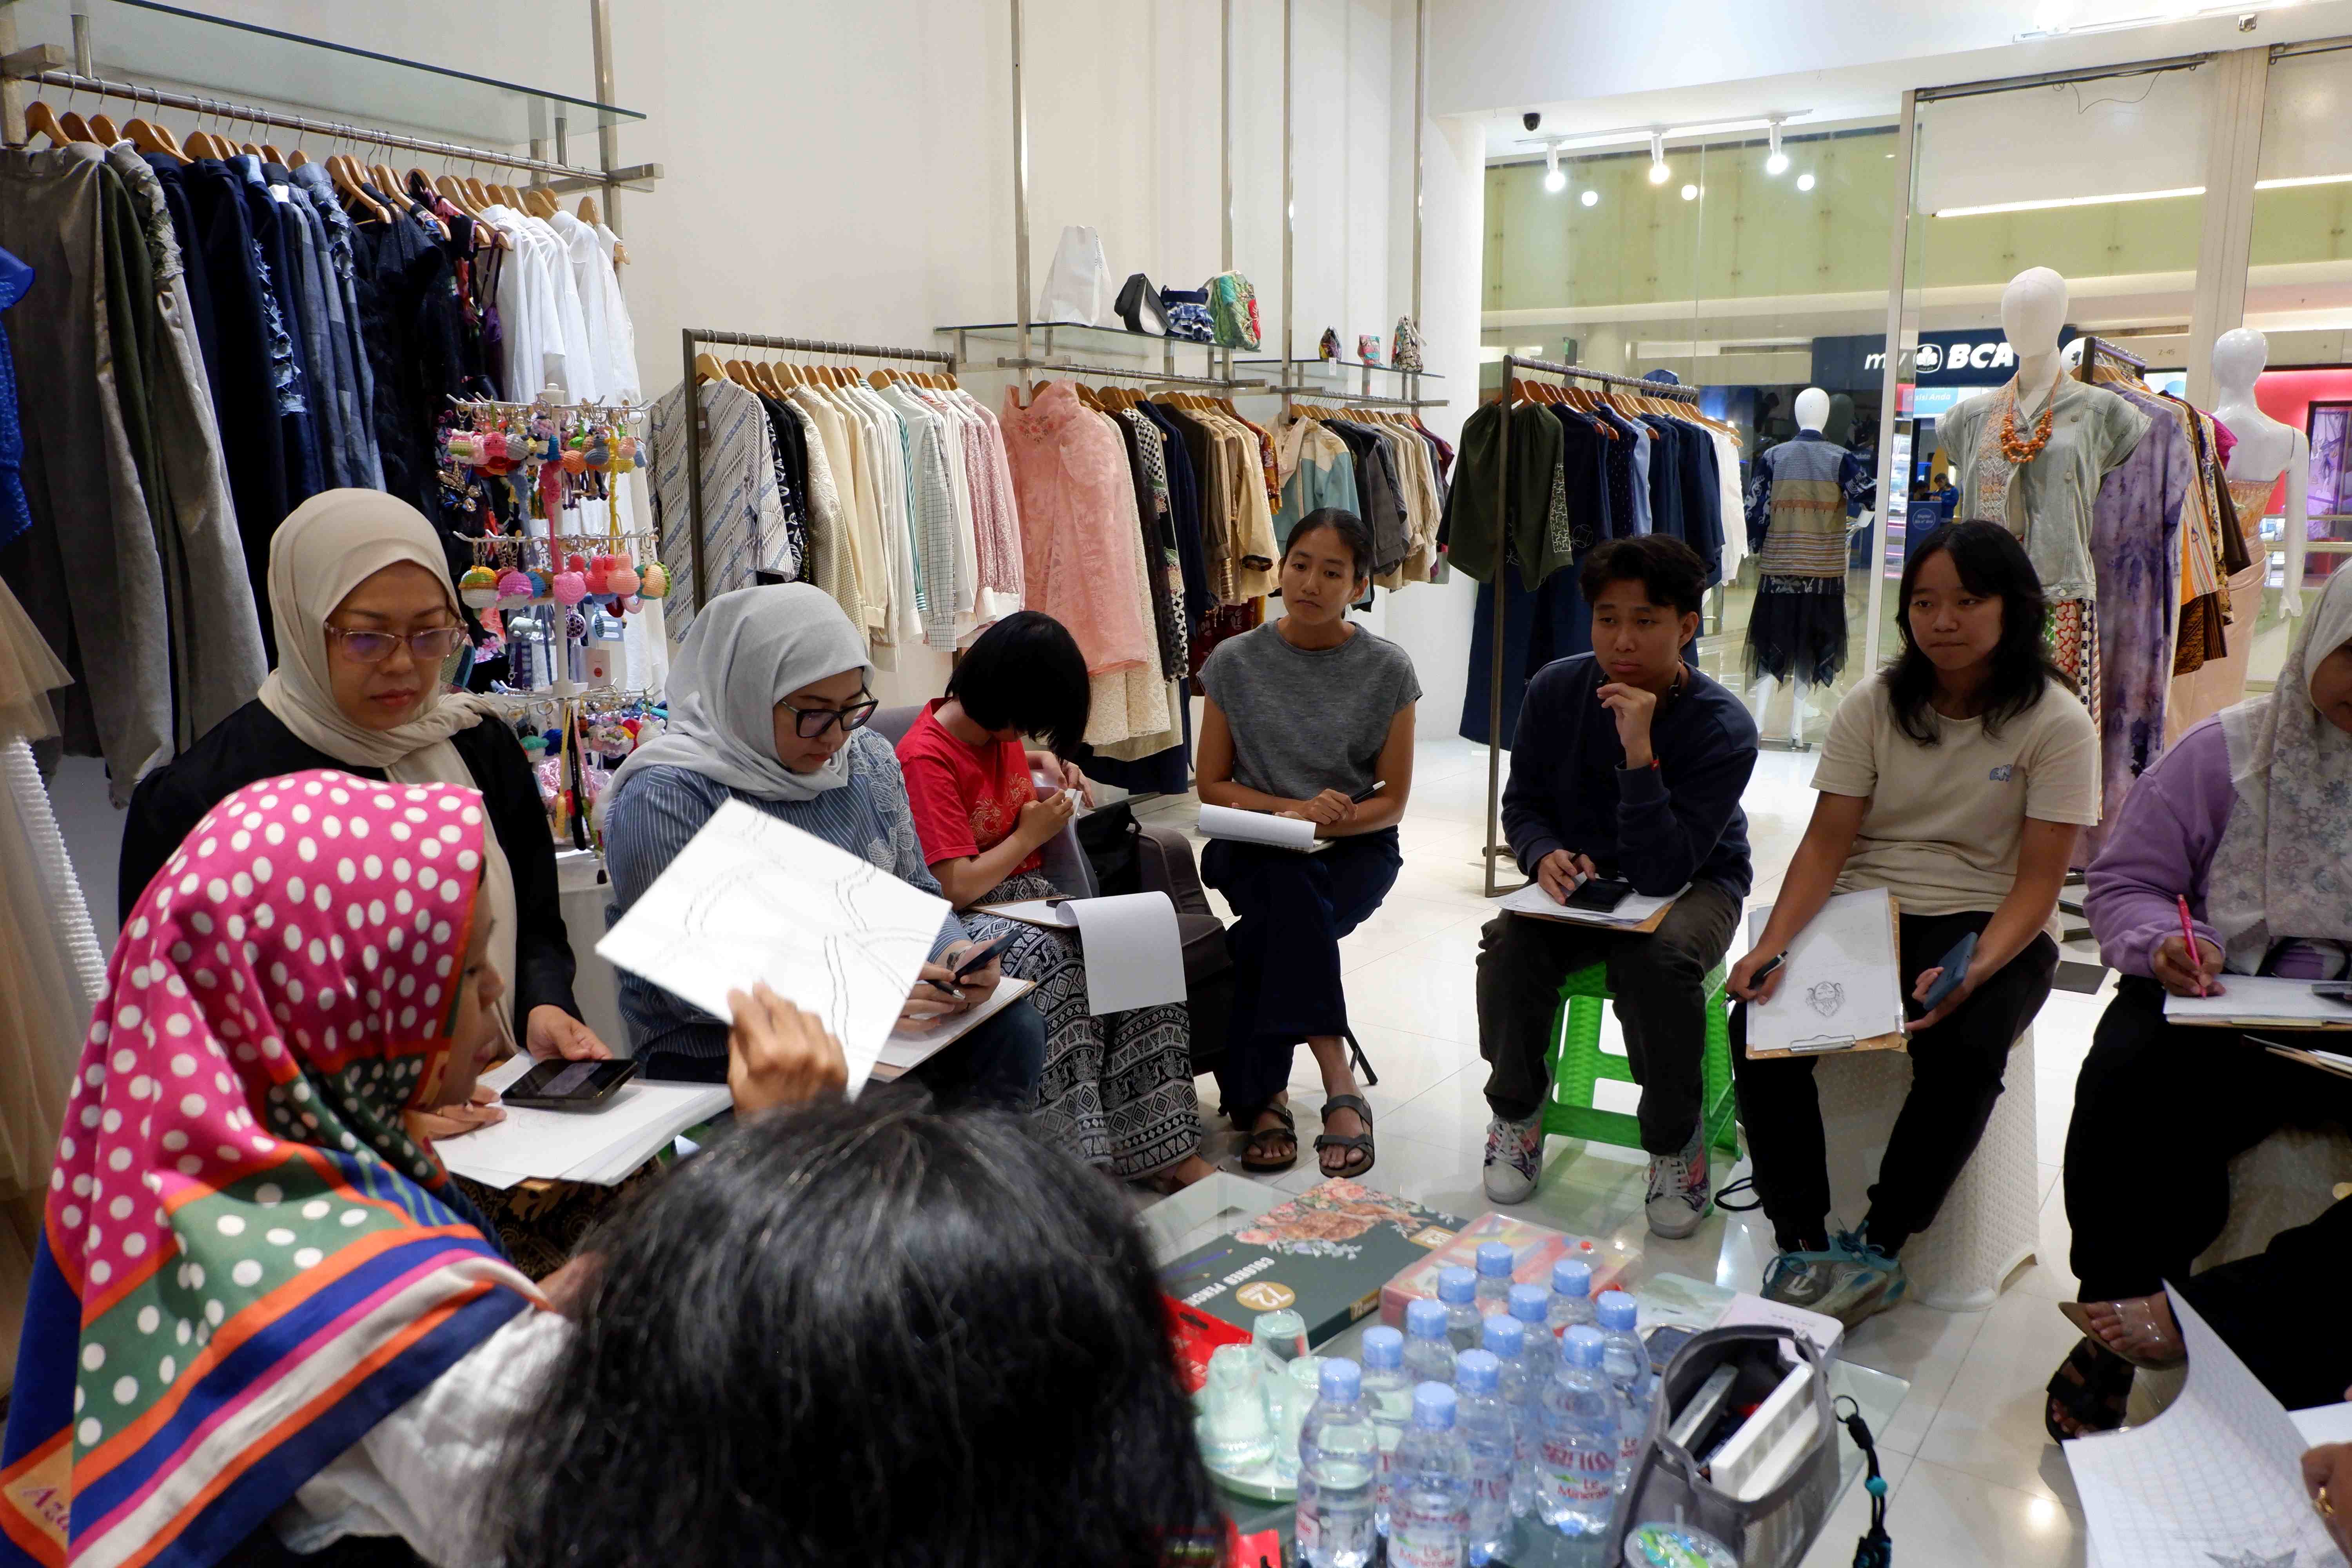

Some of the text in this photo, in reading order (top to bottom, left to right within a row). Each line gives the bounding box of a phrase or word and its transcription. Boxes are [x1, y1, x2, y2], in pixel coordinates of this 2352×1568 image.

[1947, 342, 2014, 369] BCA
[1929, 392, 1951, 401] Anda
[1223, 1257, 1275, 1285] COLORED
[1249, 1286, 1292, 1307] 72
[1583, 1478, 1599, 1490] Le
